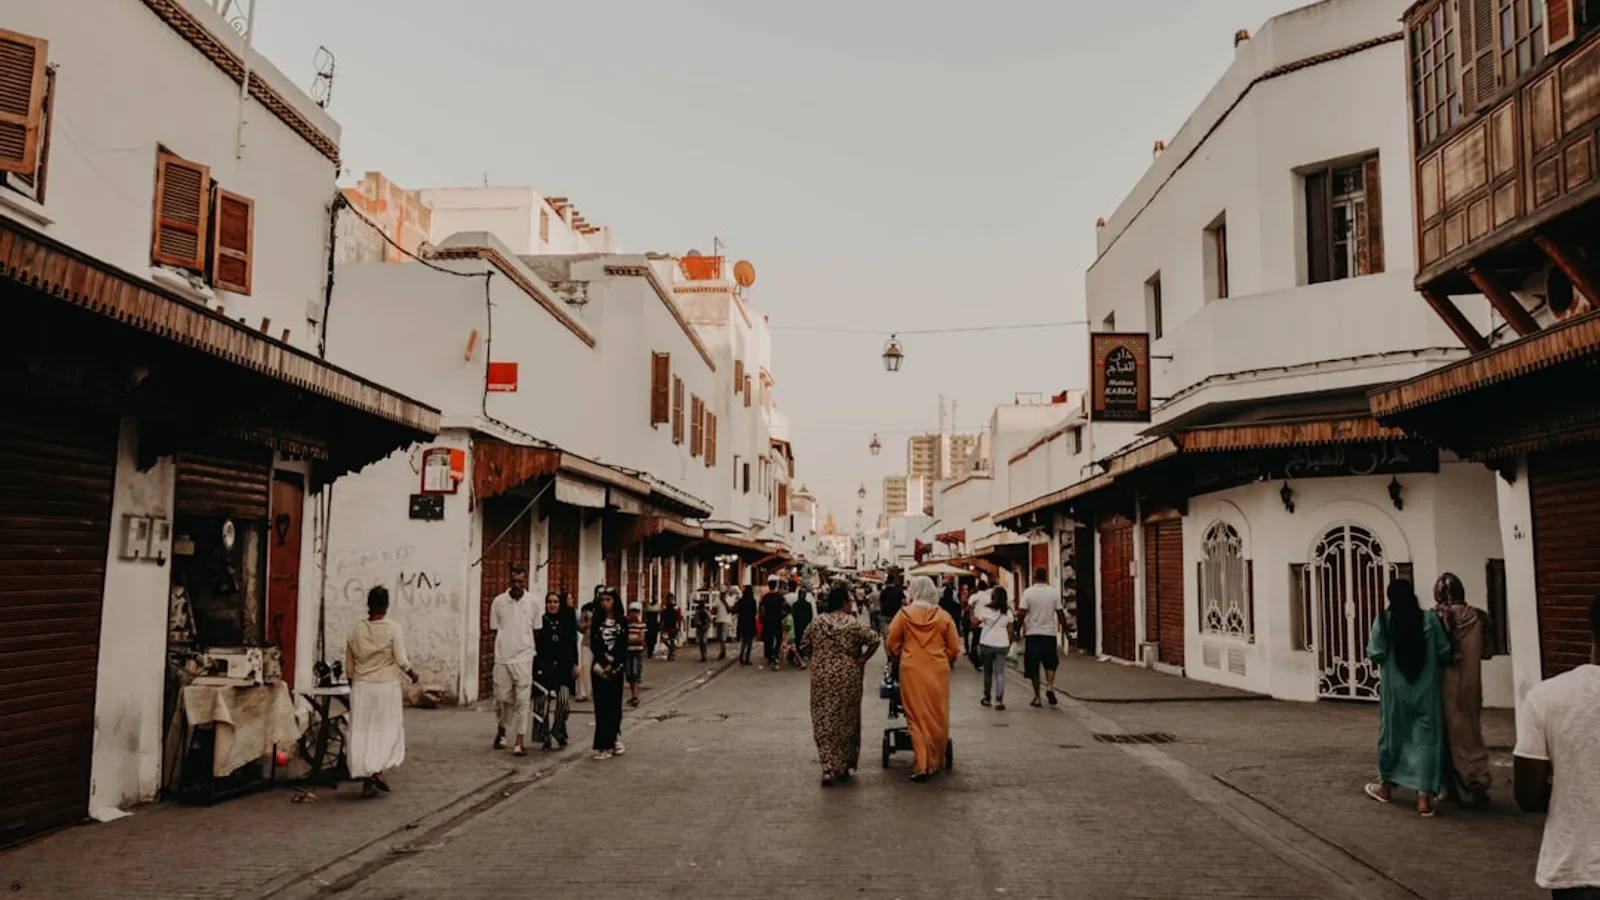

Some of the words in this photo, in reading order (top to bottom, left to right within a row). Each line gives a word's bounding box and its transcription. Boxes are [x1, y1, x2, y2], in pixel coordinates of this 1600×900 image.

[1108, 348, 1132, 362] دار
[488, 383, 515, 391] orange
[1105, 387, 1137, 395] KABBAJ
